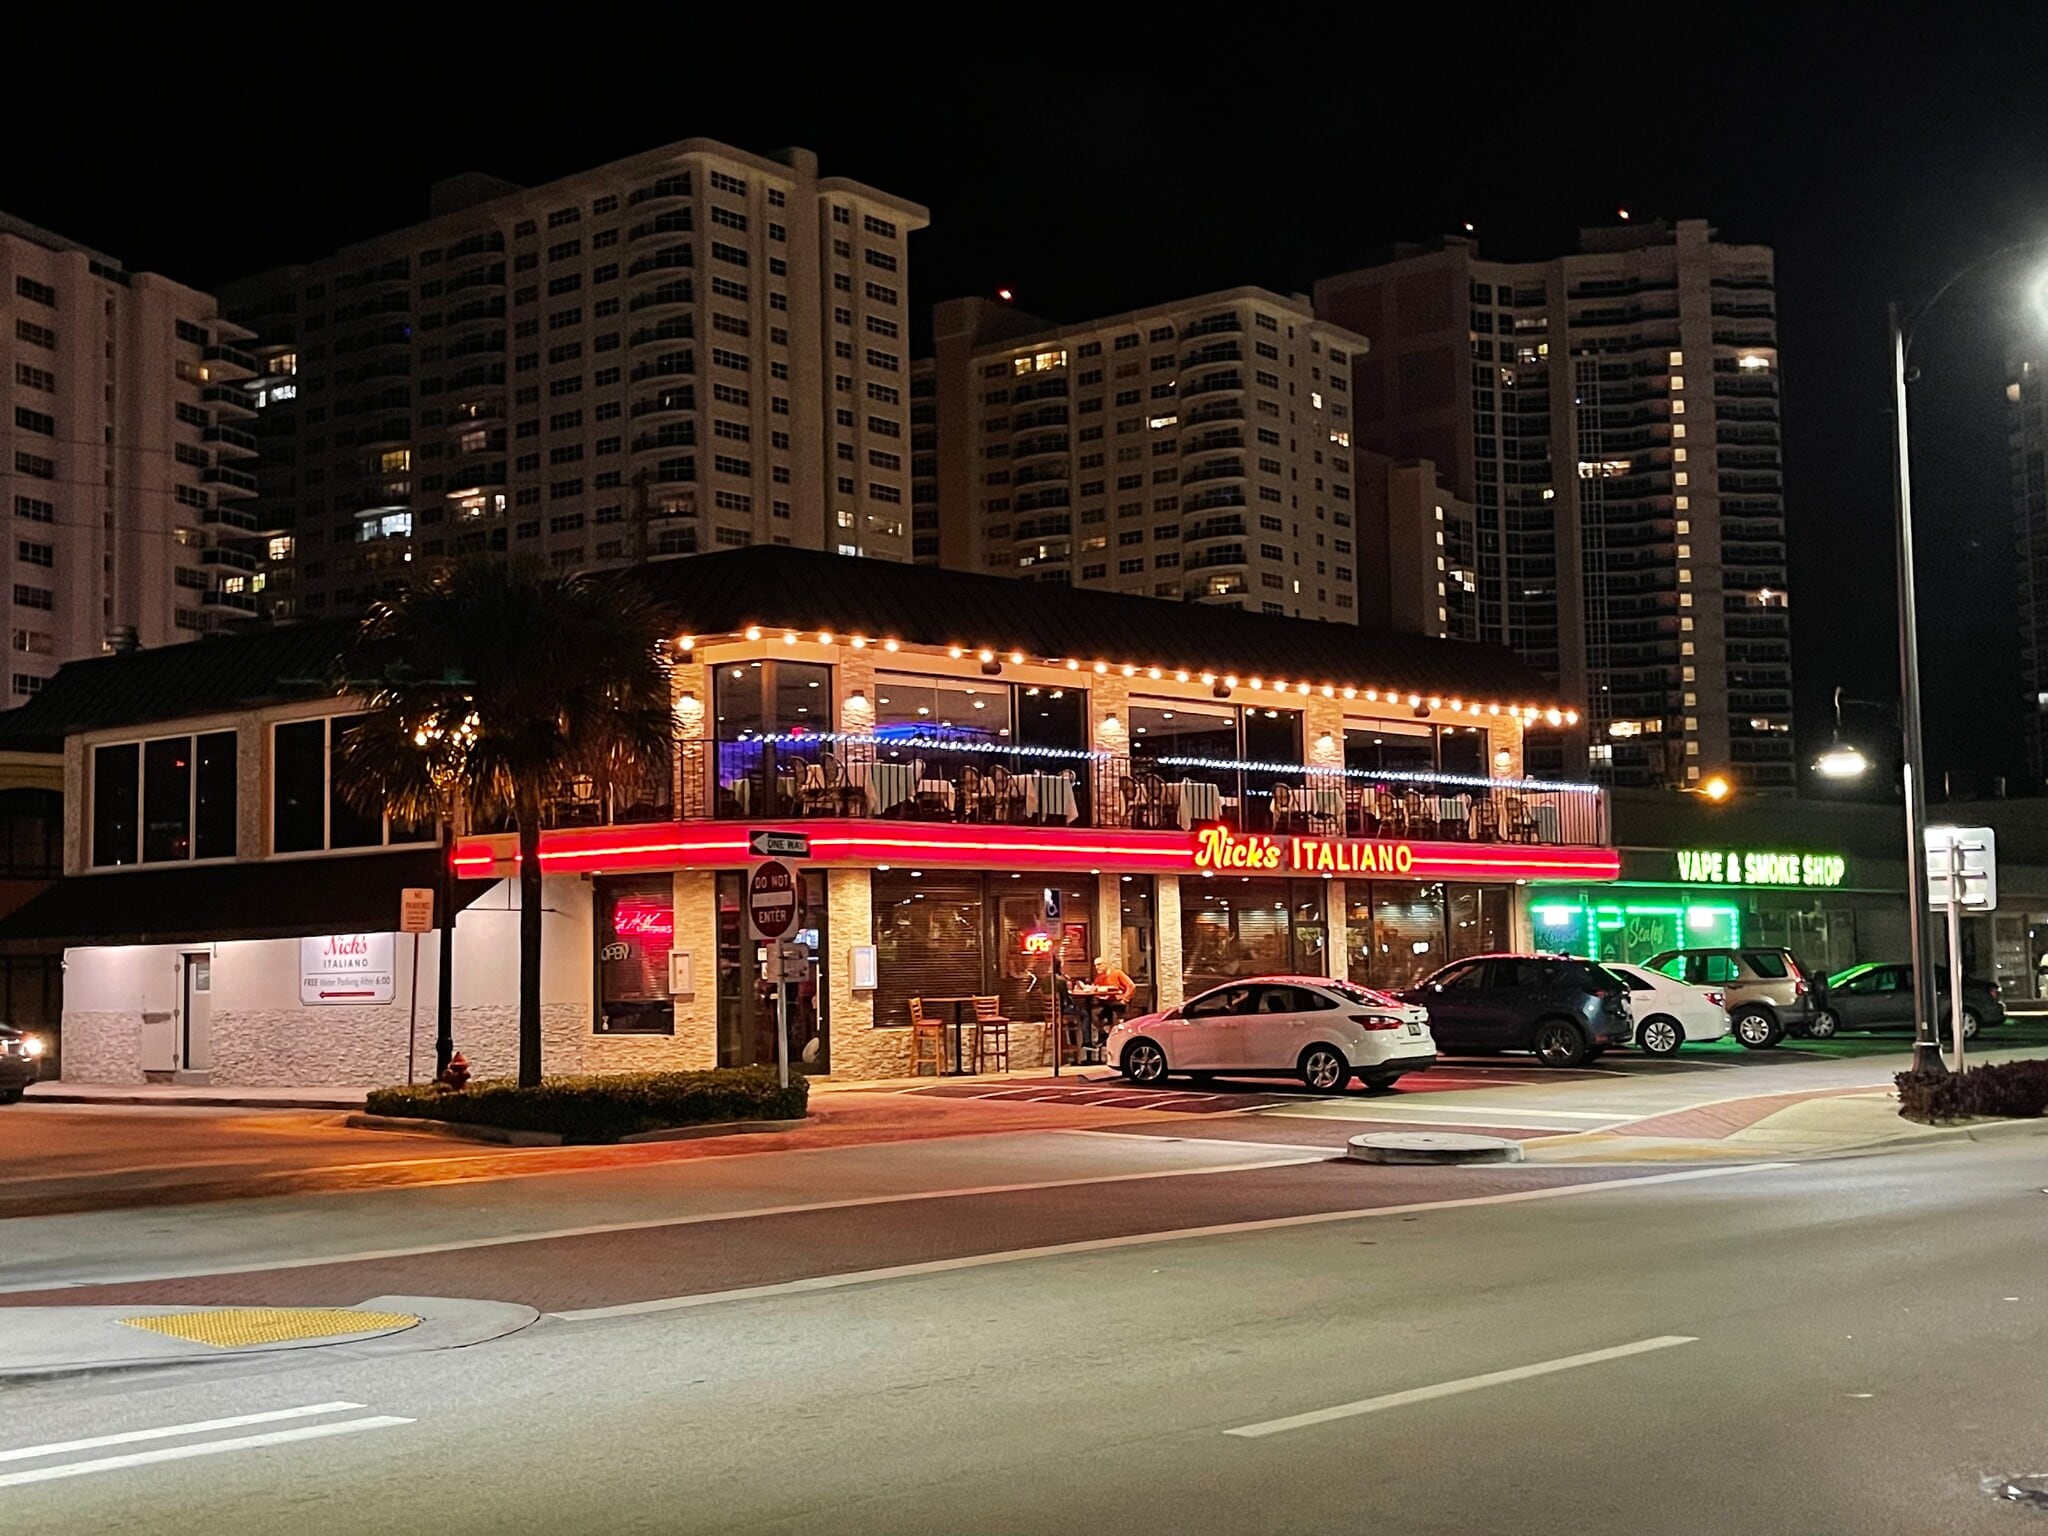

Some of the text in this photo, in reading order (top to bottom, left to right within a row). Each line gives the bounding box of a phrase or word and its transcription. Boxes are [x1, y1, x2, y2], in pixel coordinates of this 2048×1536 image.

[767, 839, 805, 851] ONE WAY
[1194, 825, 1413, 872] Nick's ITALIANO
[1677, 851, 1846, 886] VAPE & SMOKE SHOP
[755, 874, 788, 889] DO NOT
[758, 910, 787, 924] ENTER
[323, 936, 368, 956] Nick's
[601, 945, 629, 961] OPEN
[323, 958, 369, 969] ITALIANO
[303, 978, 318, 987] FREE
